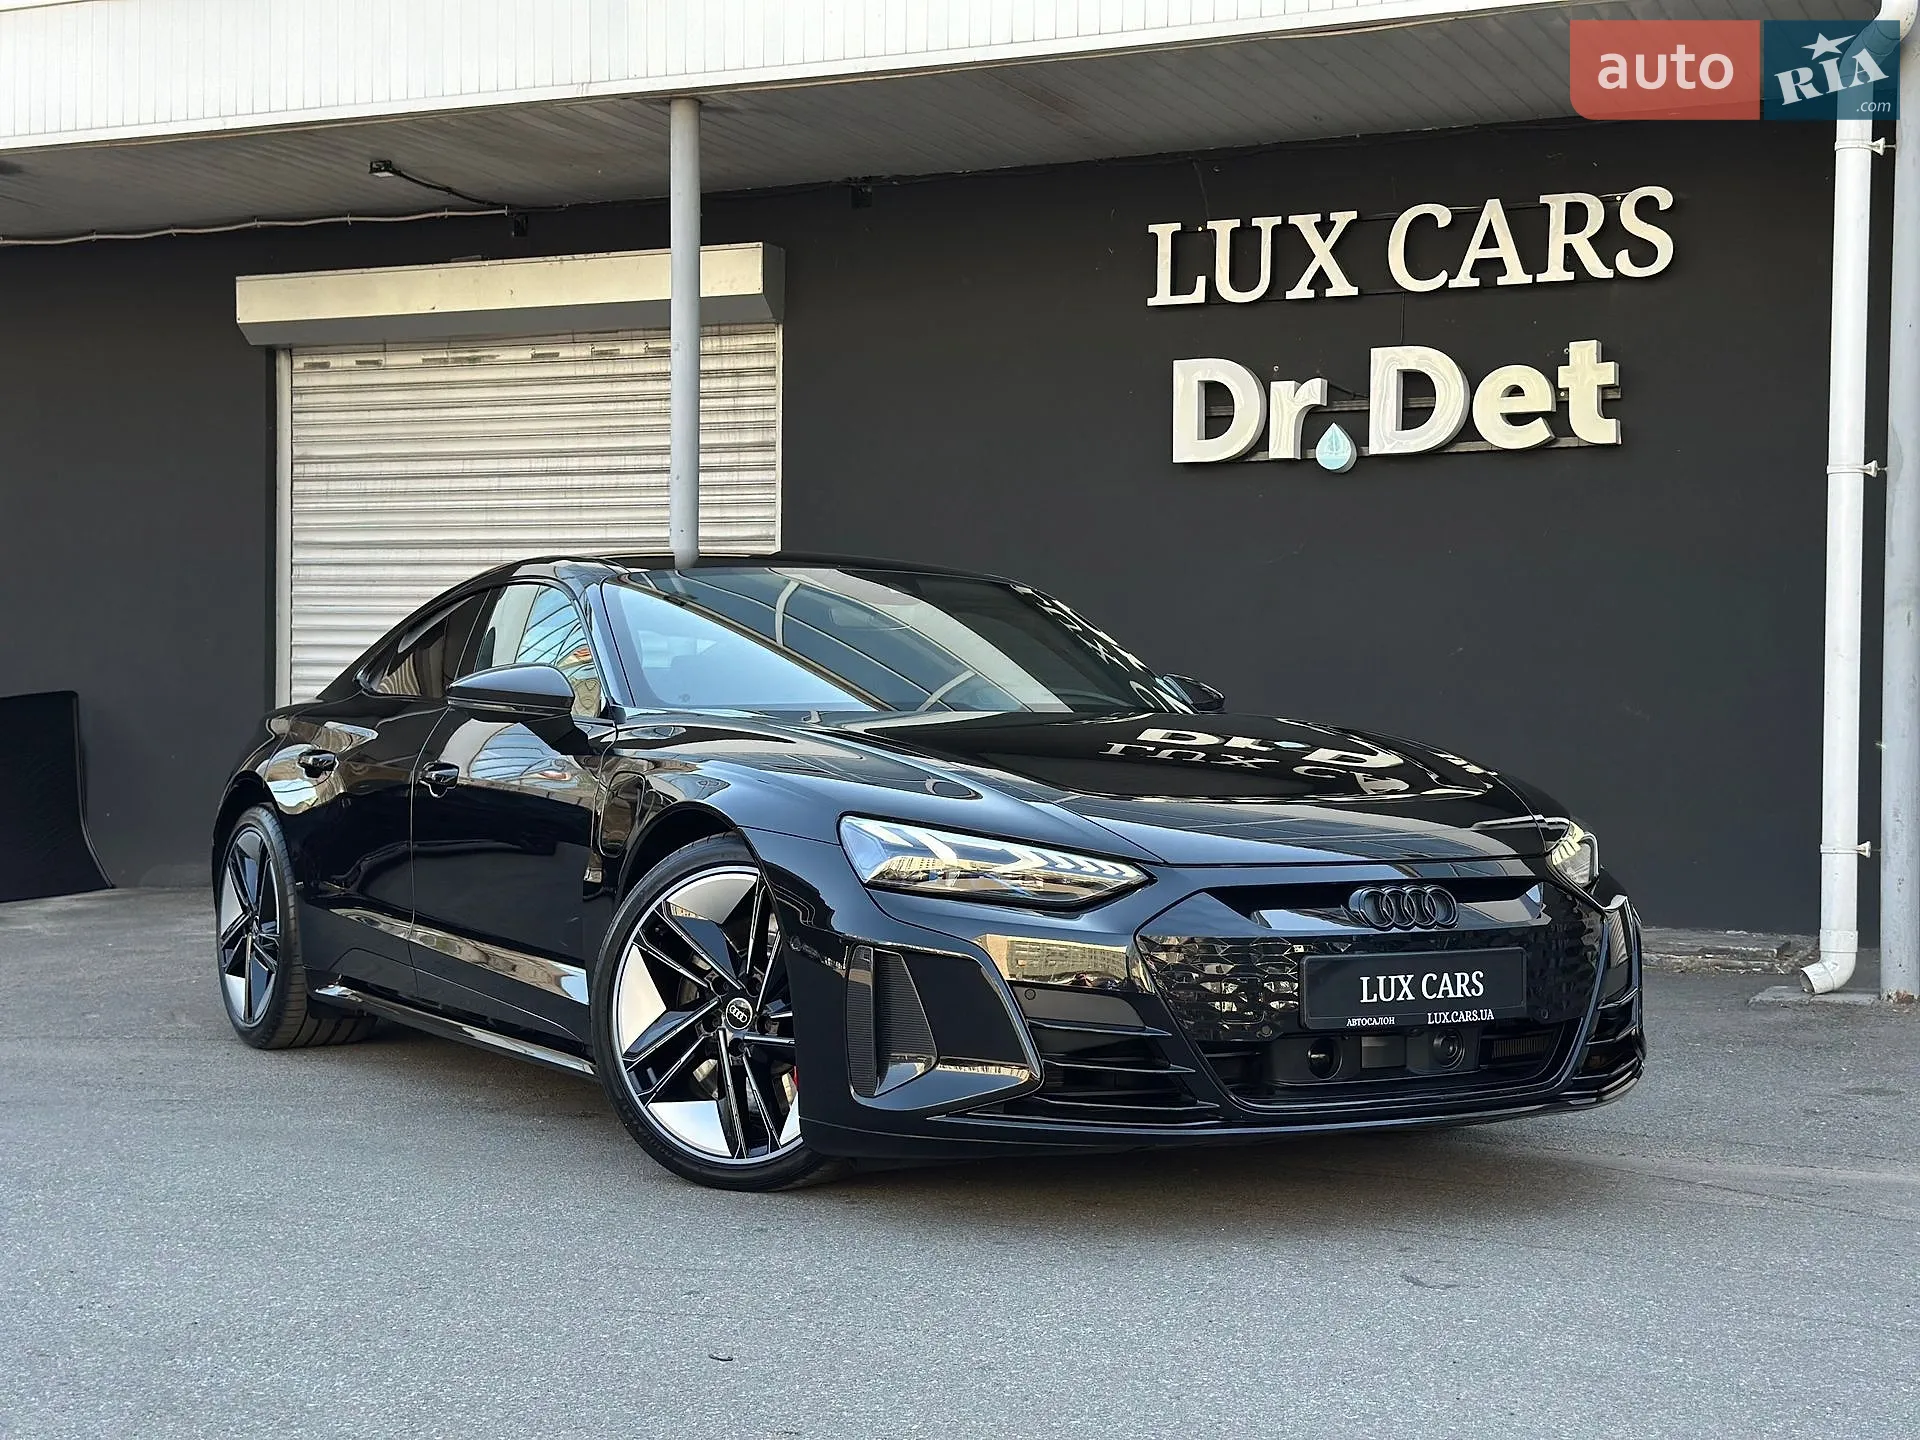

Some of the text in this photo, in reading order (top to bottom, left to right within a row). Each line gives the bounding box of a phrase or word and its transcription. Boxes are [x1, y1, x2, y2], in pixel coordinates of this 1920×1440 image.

[1147, 186, 1674, 306] LUX CARS
[1359, 970, 1484, 1003] LUX CARS
[1346, 1016, 1395, 1027] АВТОСАЛОН
[1427, 1008, 1495, 1025] LUX.CARS.UA
